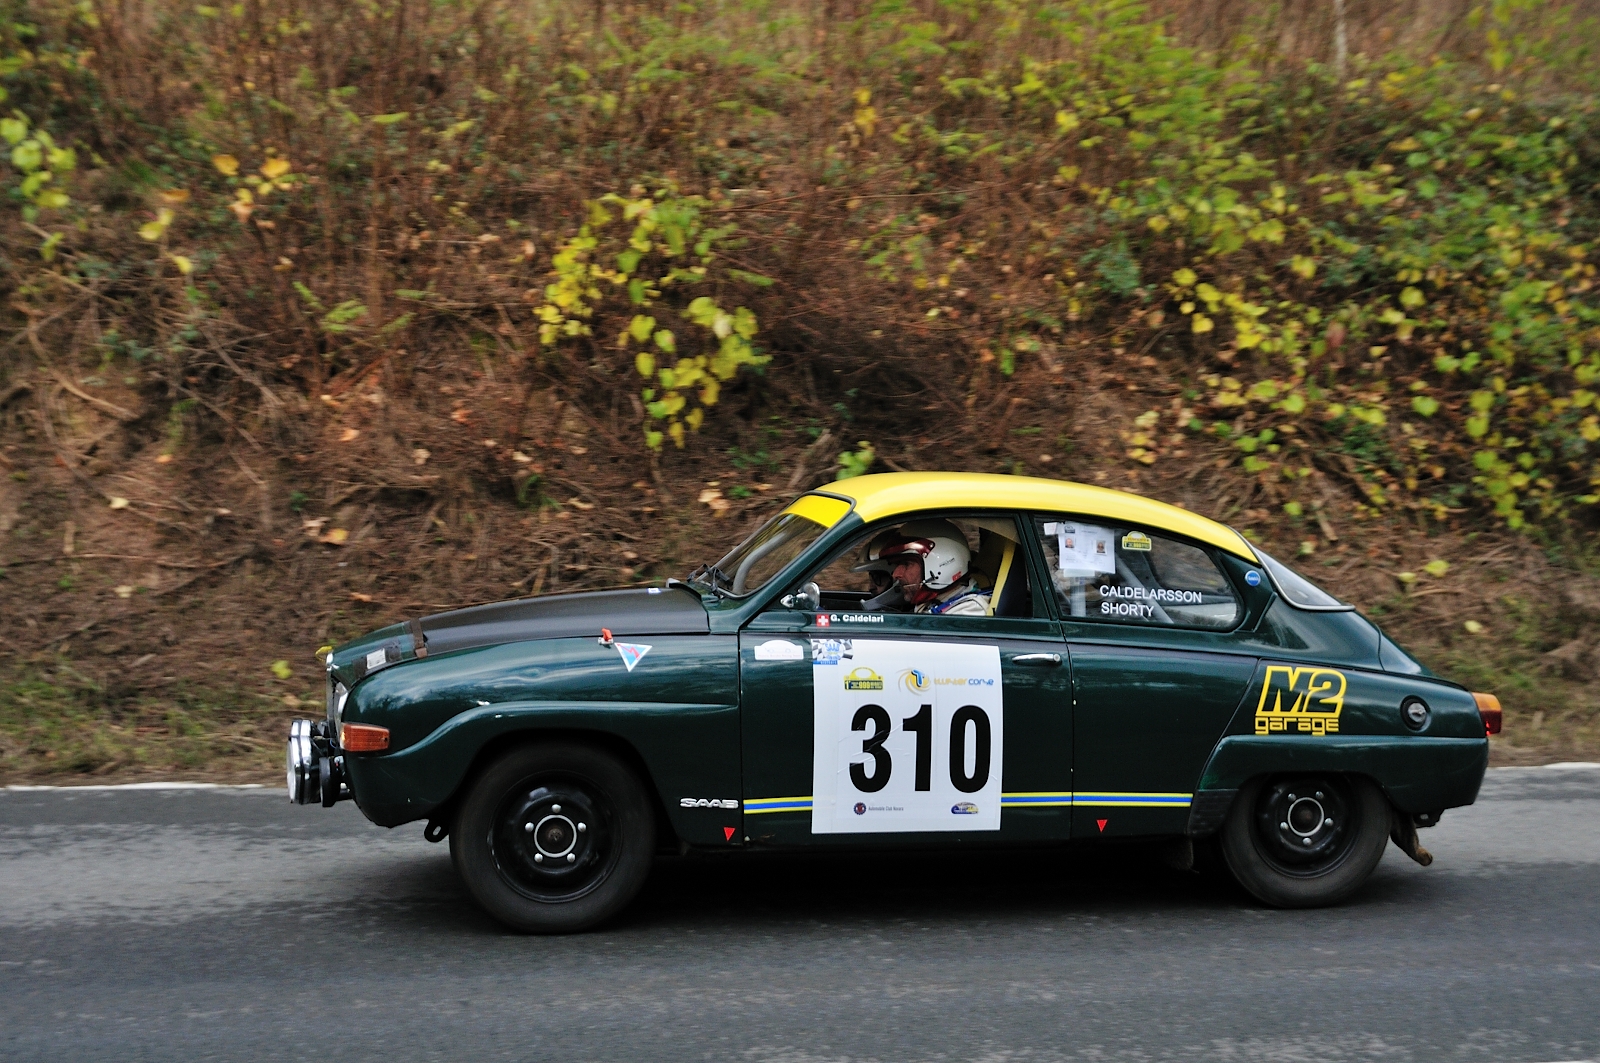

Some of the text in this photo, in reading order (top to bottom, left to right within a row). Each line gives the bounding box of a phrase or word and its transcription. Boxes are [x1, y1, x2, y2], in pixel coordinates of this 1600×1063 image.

[1100, 585, 1202, 603] CALDELARSSON
[830, 614, 884, 623] G. Caldelari
[1101, 602, 1154, 617] SHORTY
[1255, 665, 1347, 718] M2
[1255, 717, 1339, 735] garage
[849, 704, 991, 793] 310
[680, 798, 738, 808] SAAB
